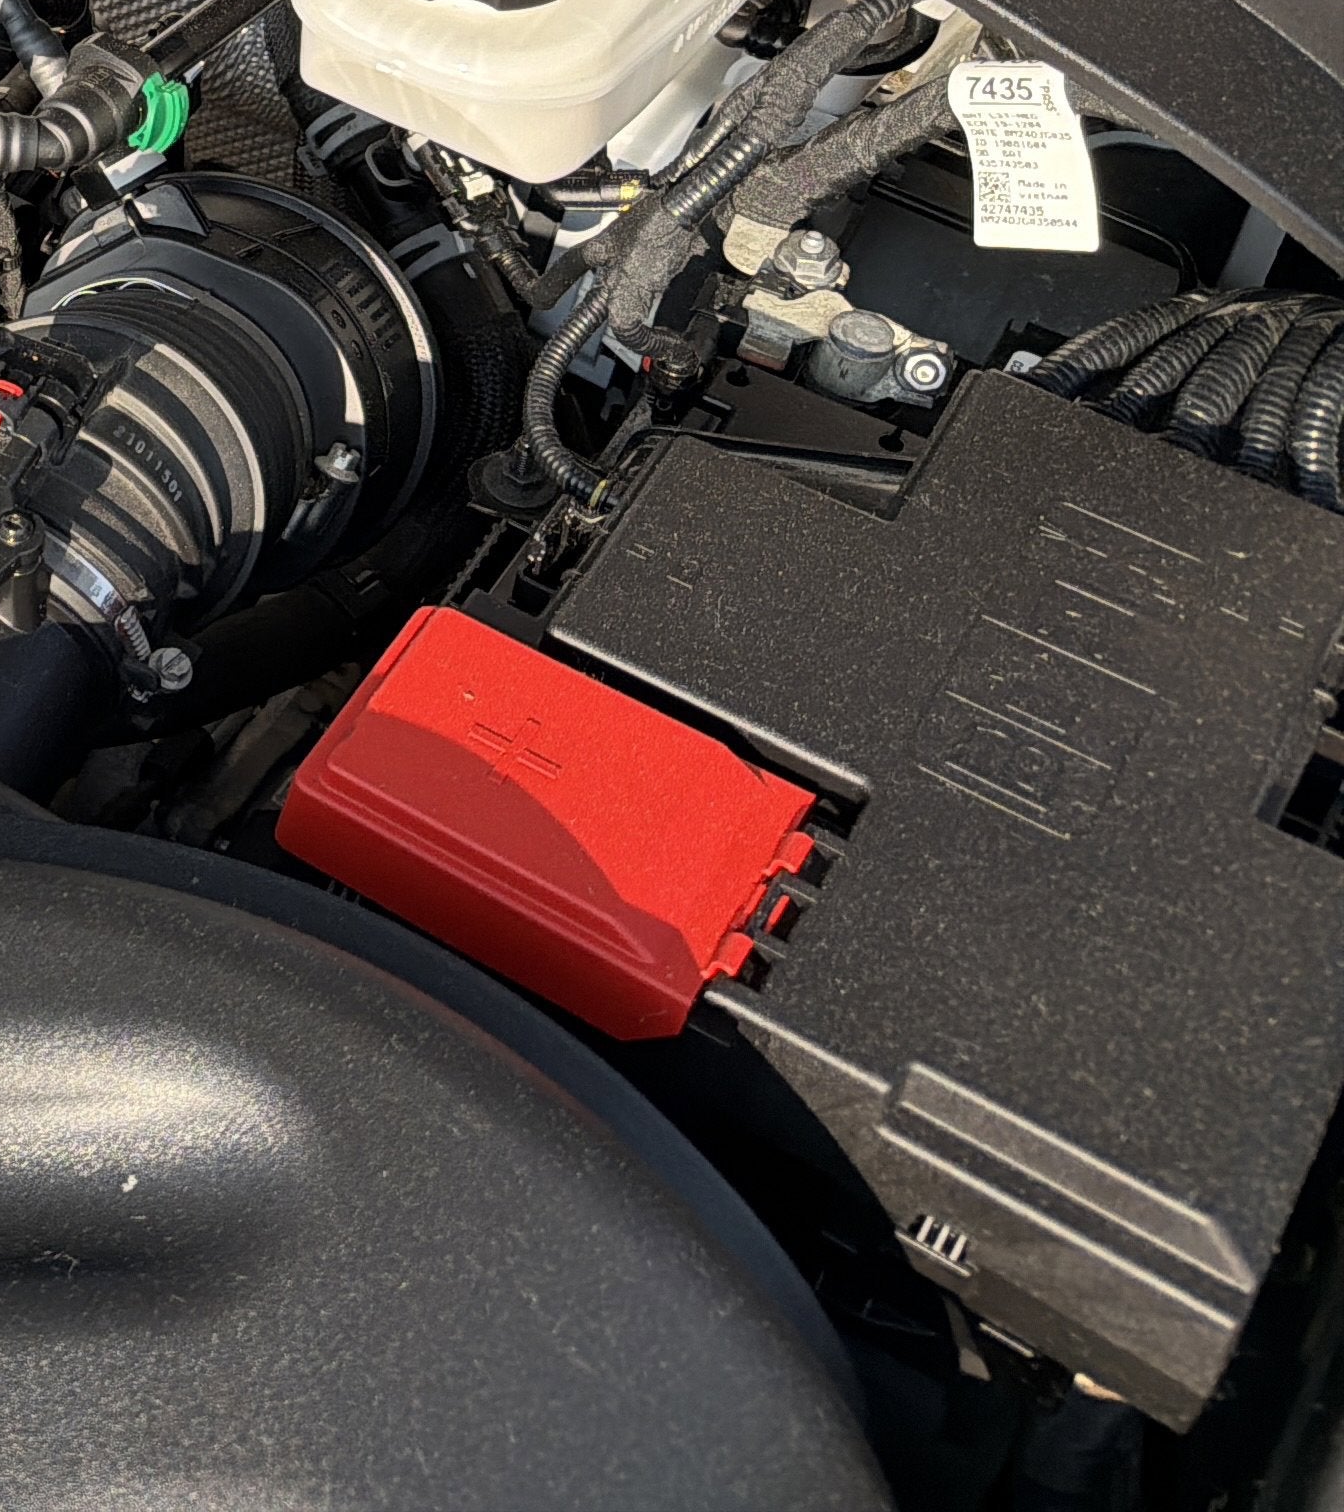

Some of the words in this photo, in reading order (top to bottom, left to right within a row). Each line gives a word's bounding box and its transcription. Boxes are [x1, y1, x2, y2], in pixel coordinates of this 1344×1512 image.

[966, 76, 1033, 101] 7435
[971, 128, 998, 137] DATE
[1017, 179, 1046, 188] Made
[1054, 181, 1068, 190] in
[980, 204, 1045, 217] 42747435
[112, 425, 183, 503] 21011501
